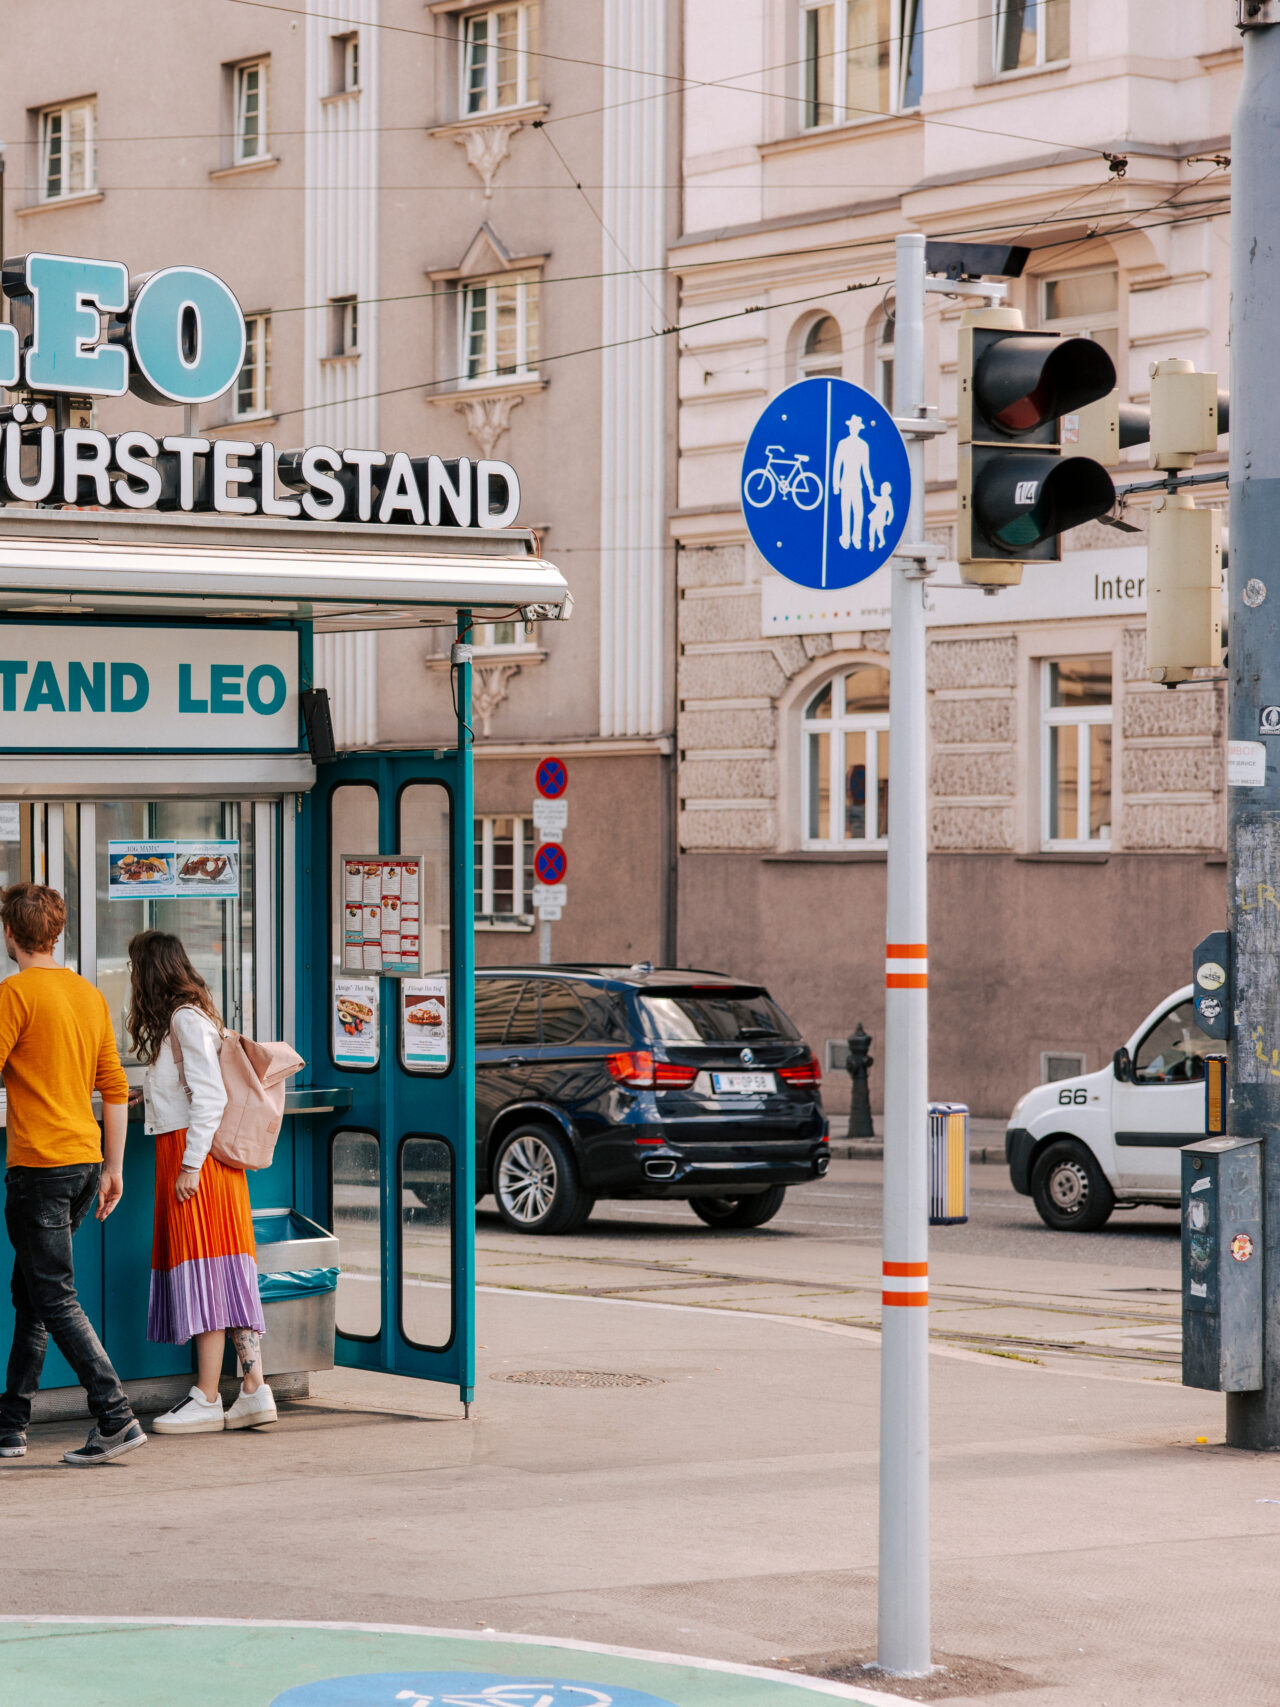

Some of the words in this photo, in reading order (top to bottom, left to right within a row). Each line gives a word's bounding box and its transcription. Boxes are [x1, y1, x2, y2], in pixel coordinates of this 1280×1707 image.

[1017, 482, 1036, 503] 14
[1094, 573, 1146, 601] Inter
[178, 663, 288, 716] LEO
[1058, 1088, 1088, 1105] 66
